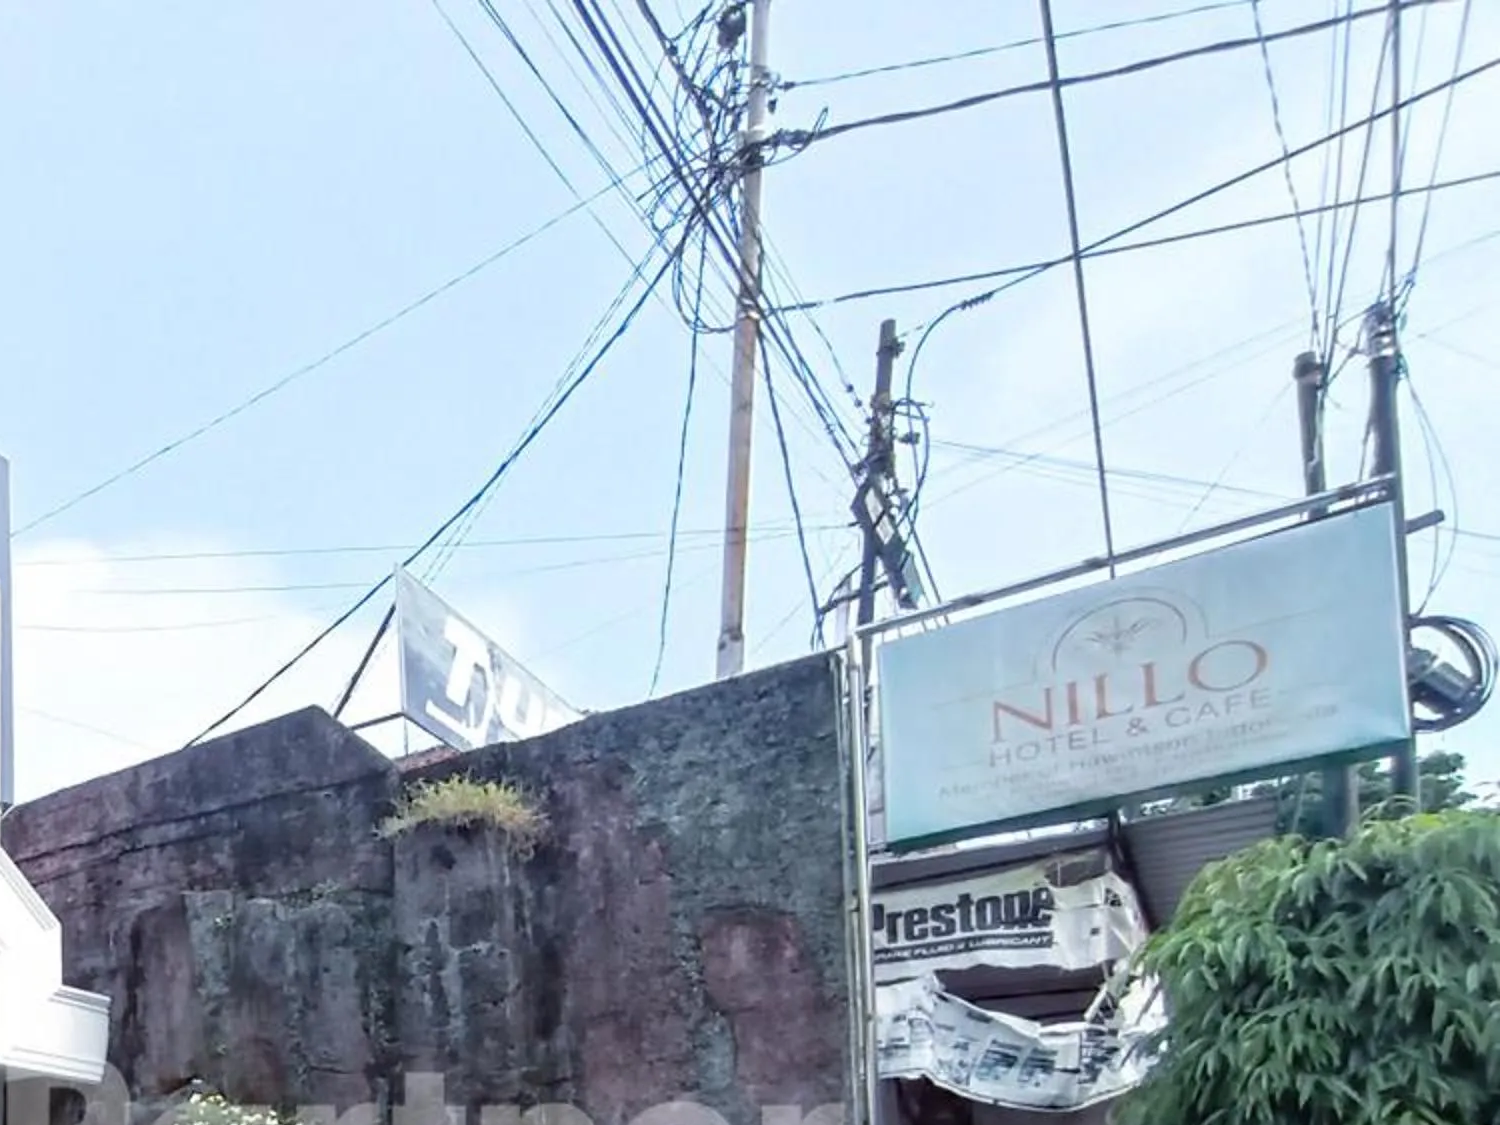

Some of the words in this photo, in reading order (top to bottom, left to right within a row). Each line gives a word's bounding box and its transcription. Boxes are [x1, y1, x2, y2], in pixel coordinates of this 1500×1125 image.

[989, 640, 1268, 743] NILLO
[989, 727, 1112, 768] HOTEL
[1125, 716, 1149, 738] &
[1165, 685, 1272, 728] CAFE
